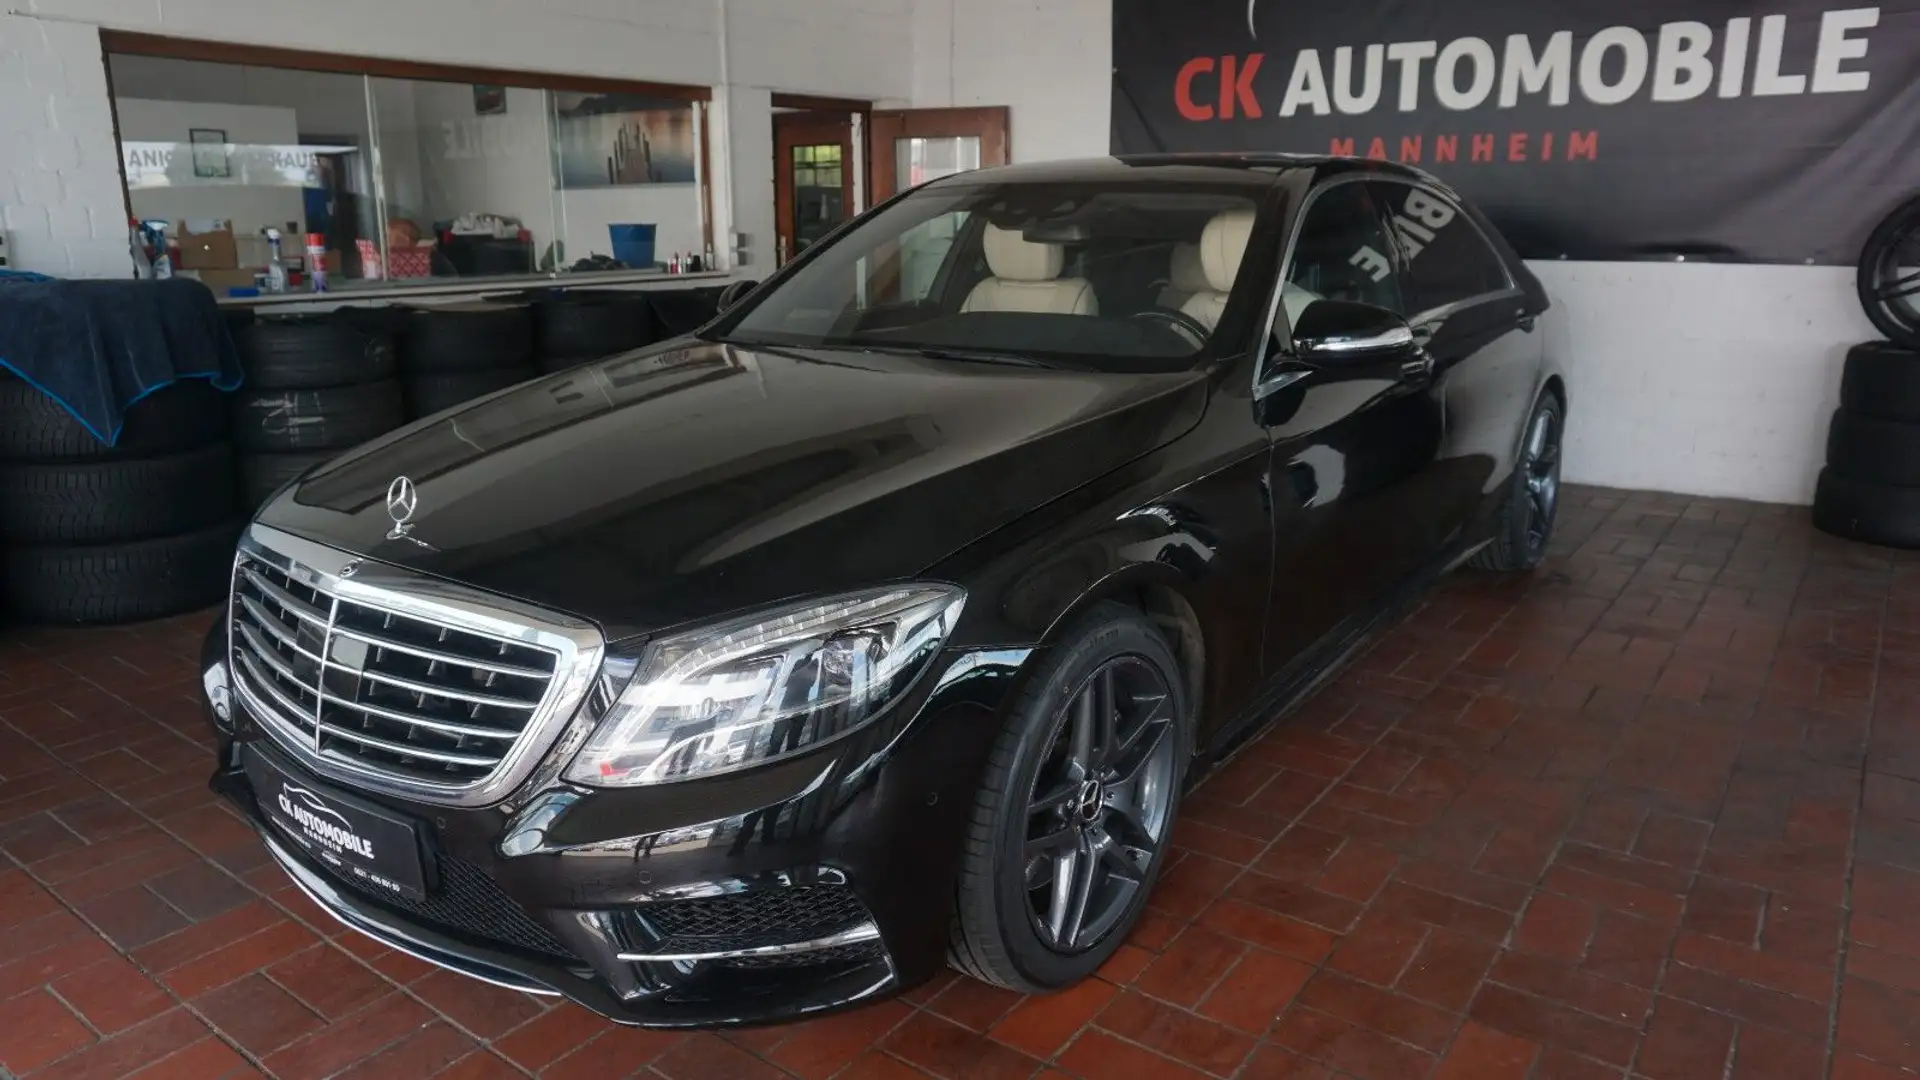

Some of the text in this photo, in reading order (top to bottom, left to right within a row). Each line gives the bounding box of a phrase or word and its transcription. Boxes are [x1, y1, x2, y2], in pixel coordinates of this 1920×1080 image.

[1174, 7, 1880, 121] CK AUTOMOBILE
[1330, 131, 1599, 162] MANNHEIM
[278, 793, 294, 818] CK
[293, 804, 375, 859] AUTOMOBILE
